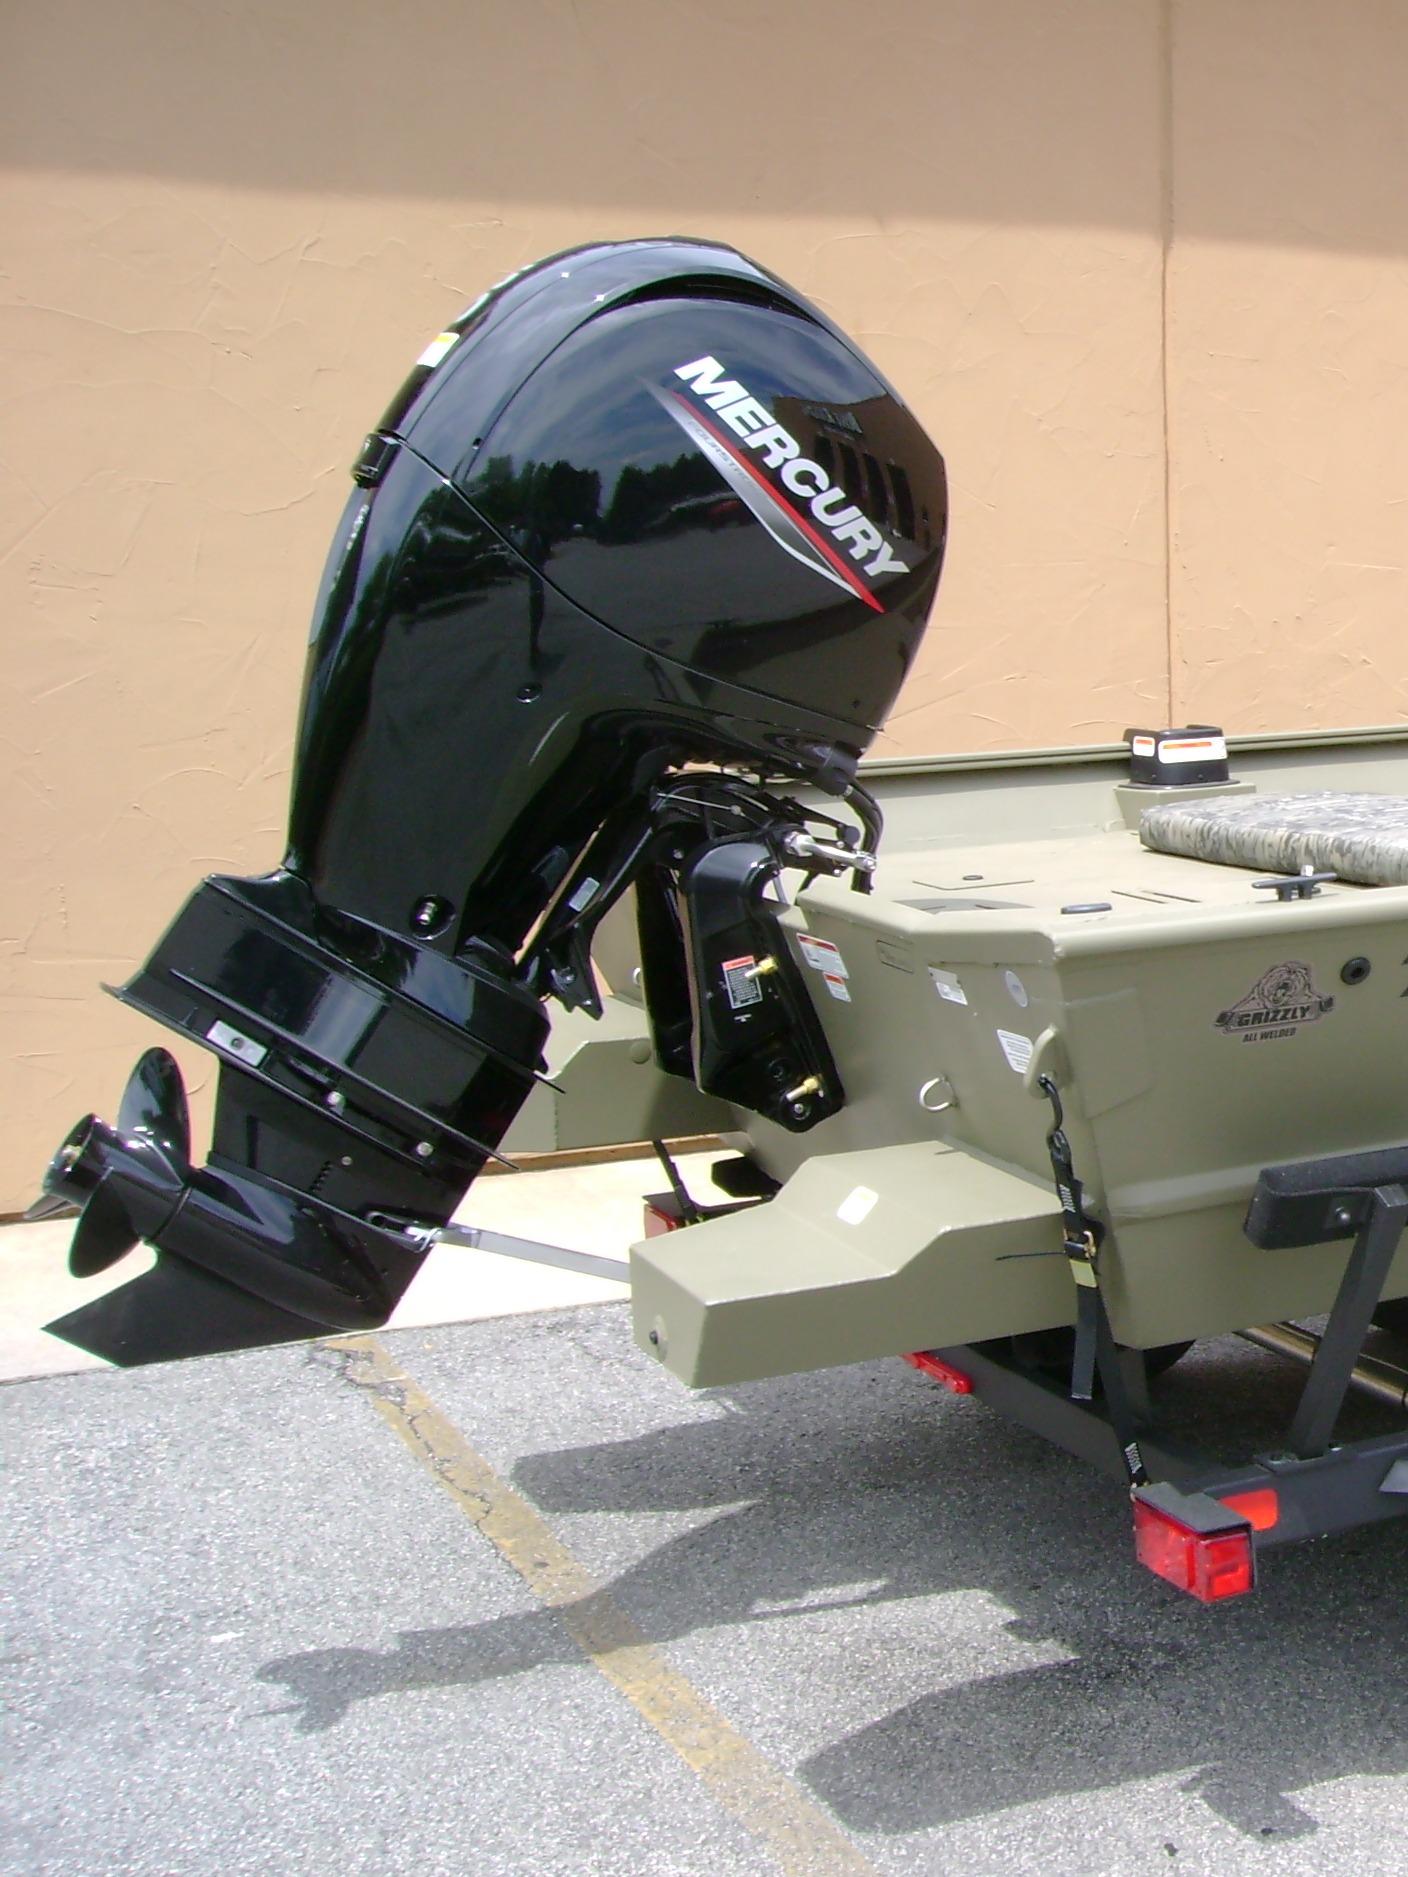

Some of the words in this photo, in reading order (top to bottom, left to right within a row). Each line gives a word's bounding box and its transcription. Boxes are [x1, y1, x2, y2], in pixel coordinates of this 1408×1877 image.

[673, 355, 910, 577] MERCURY
[1238, 1005, 1310, 1027] GRIZZLY
[1242, 1031, 1258, 1043] ALL
[1260, 1027, 1297, 1040] WELDED
